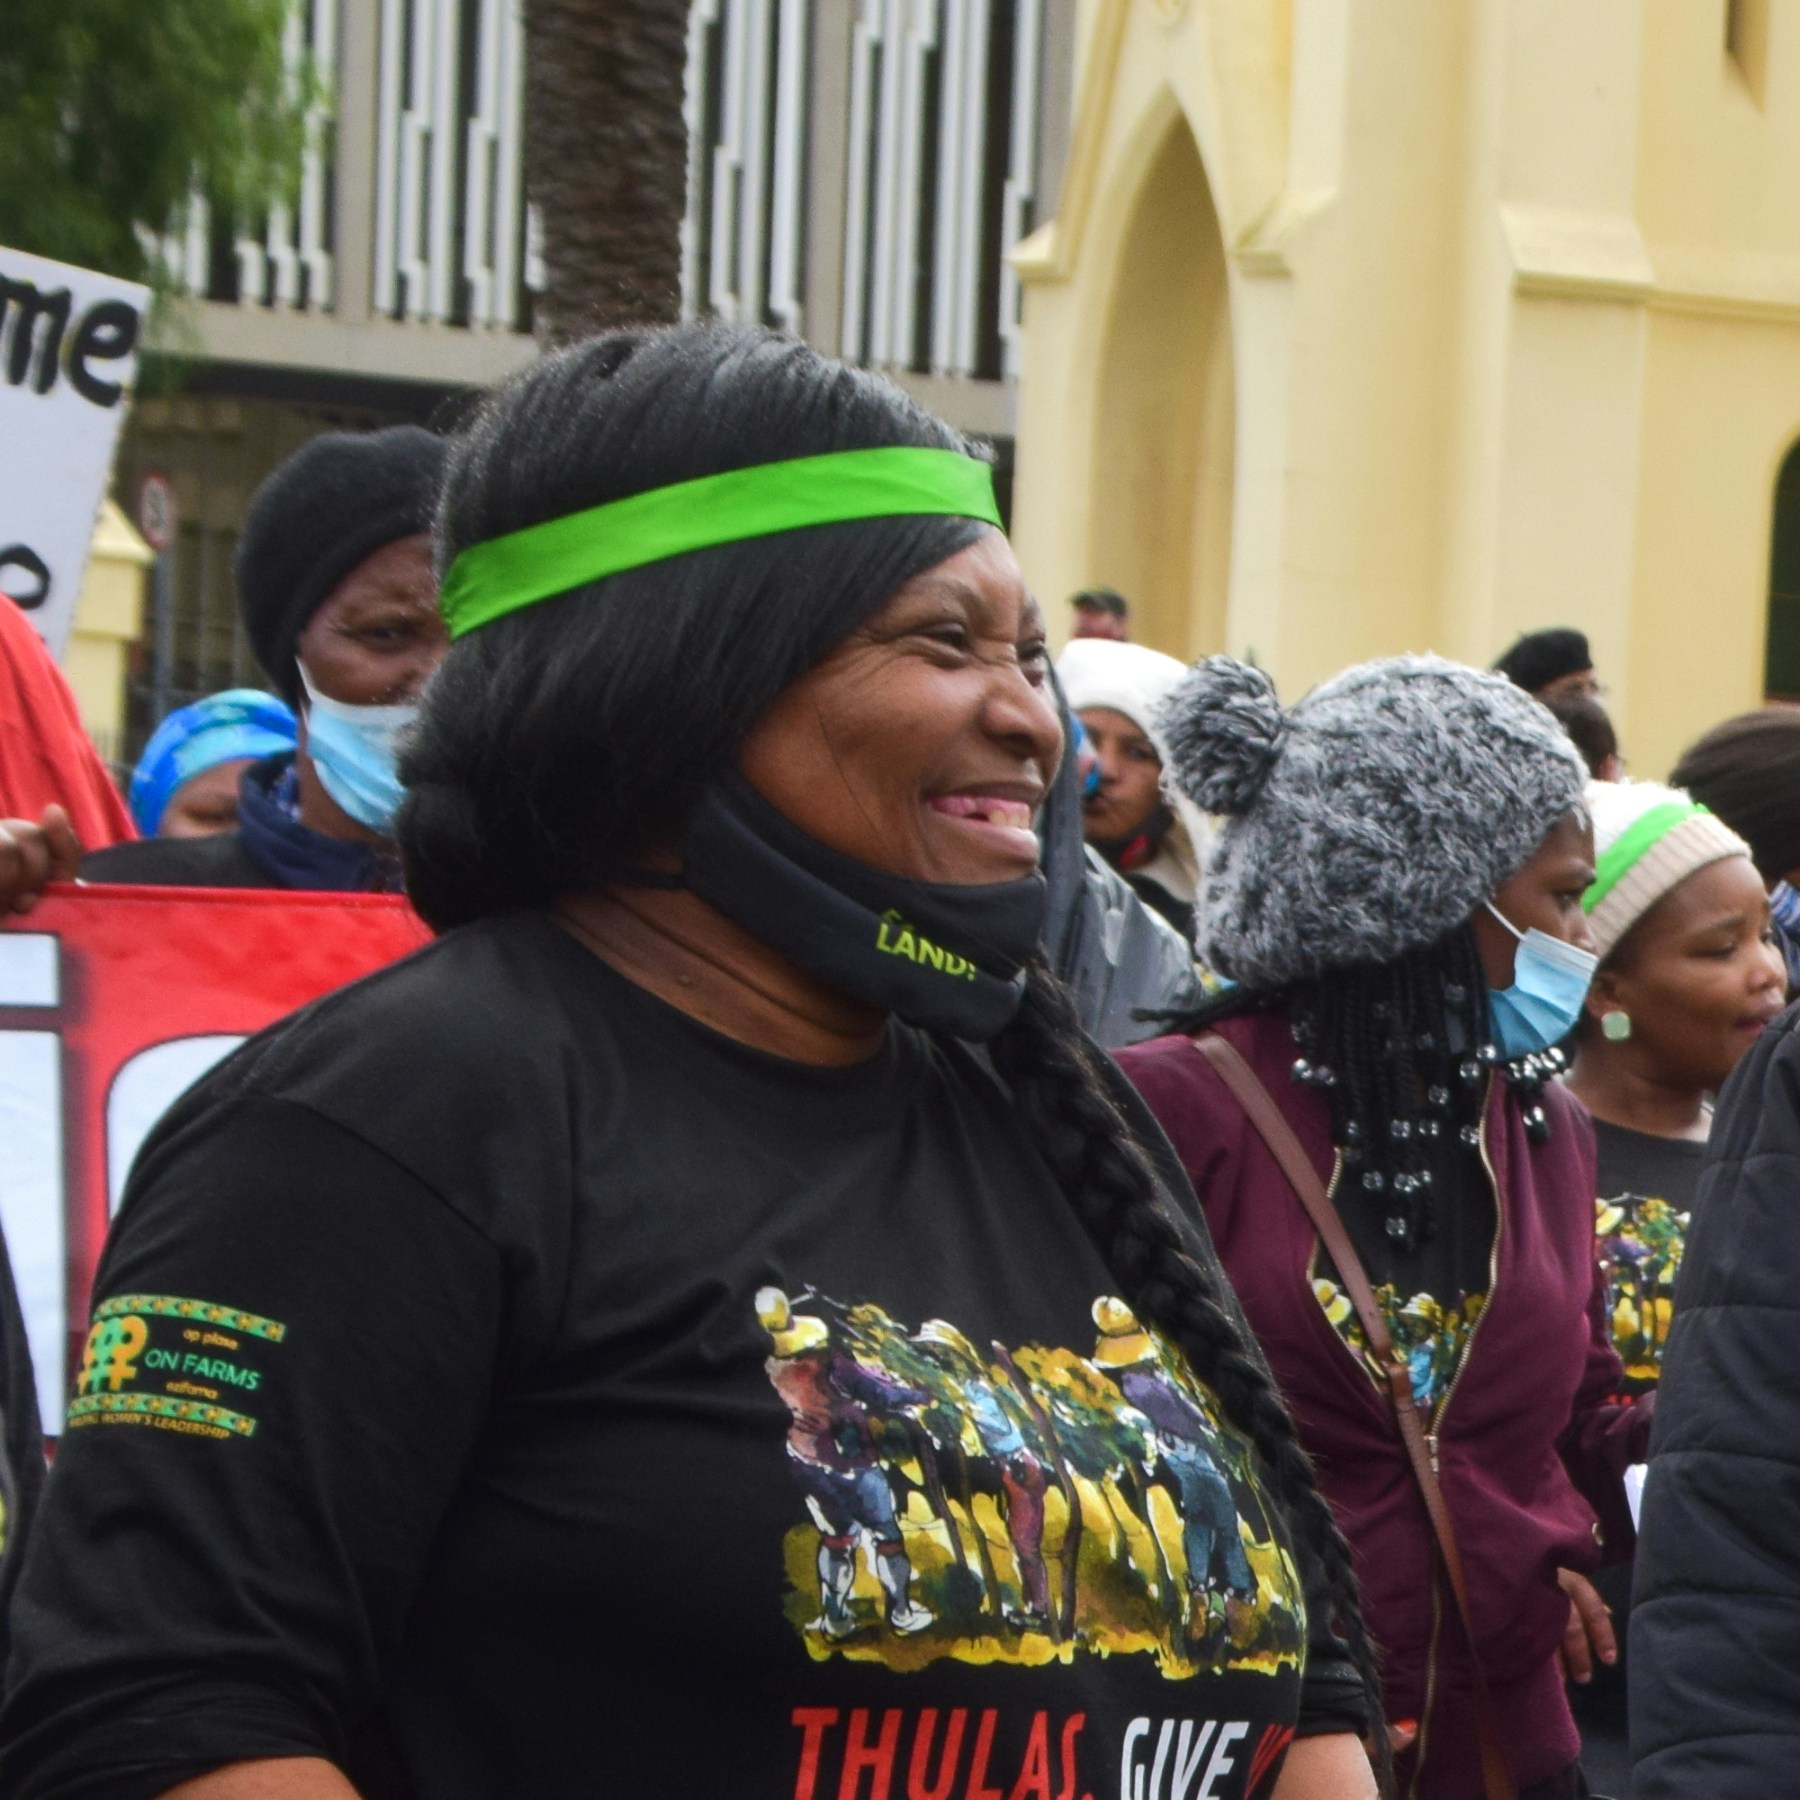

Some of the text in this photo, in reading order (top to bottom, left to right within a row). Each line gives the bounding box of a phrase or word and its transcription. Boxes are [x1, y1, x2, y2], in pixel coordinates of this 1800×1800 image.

[144, 1348, 262, 1392] ON FARMS
[154, 1415, 231, 1440] LEADERSHIP
